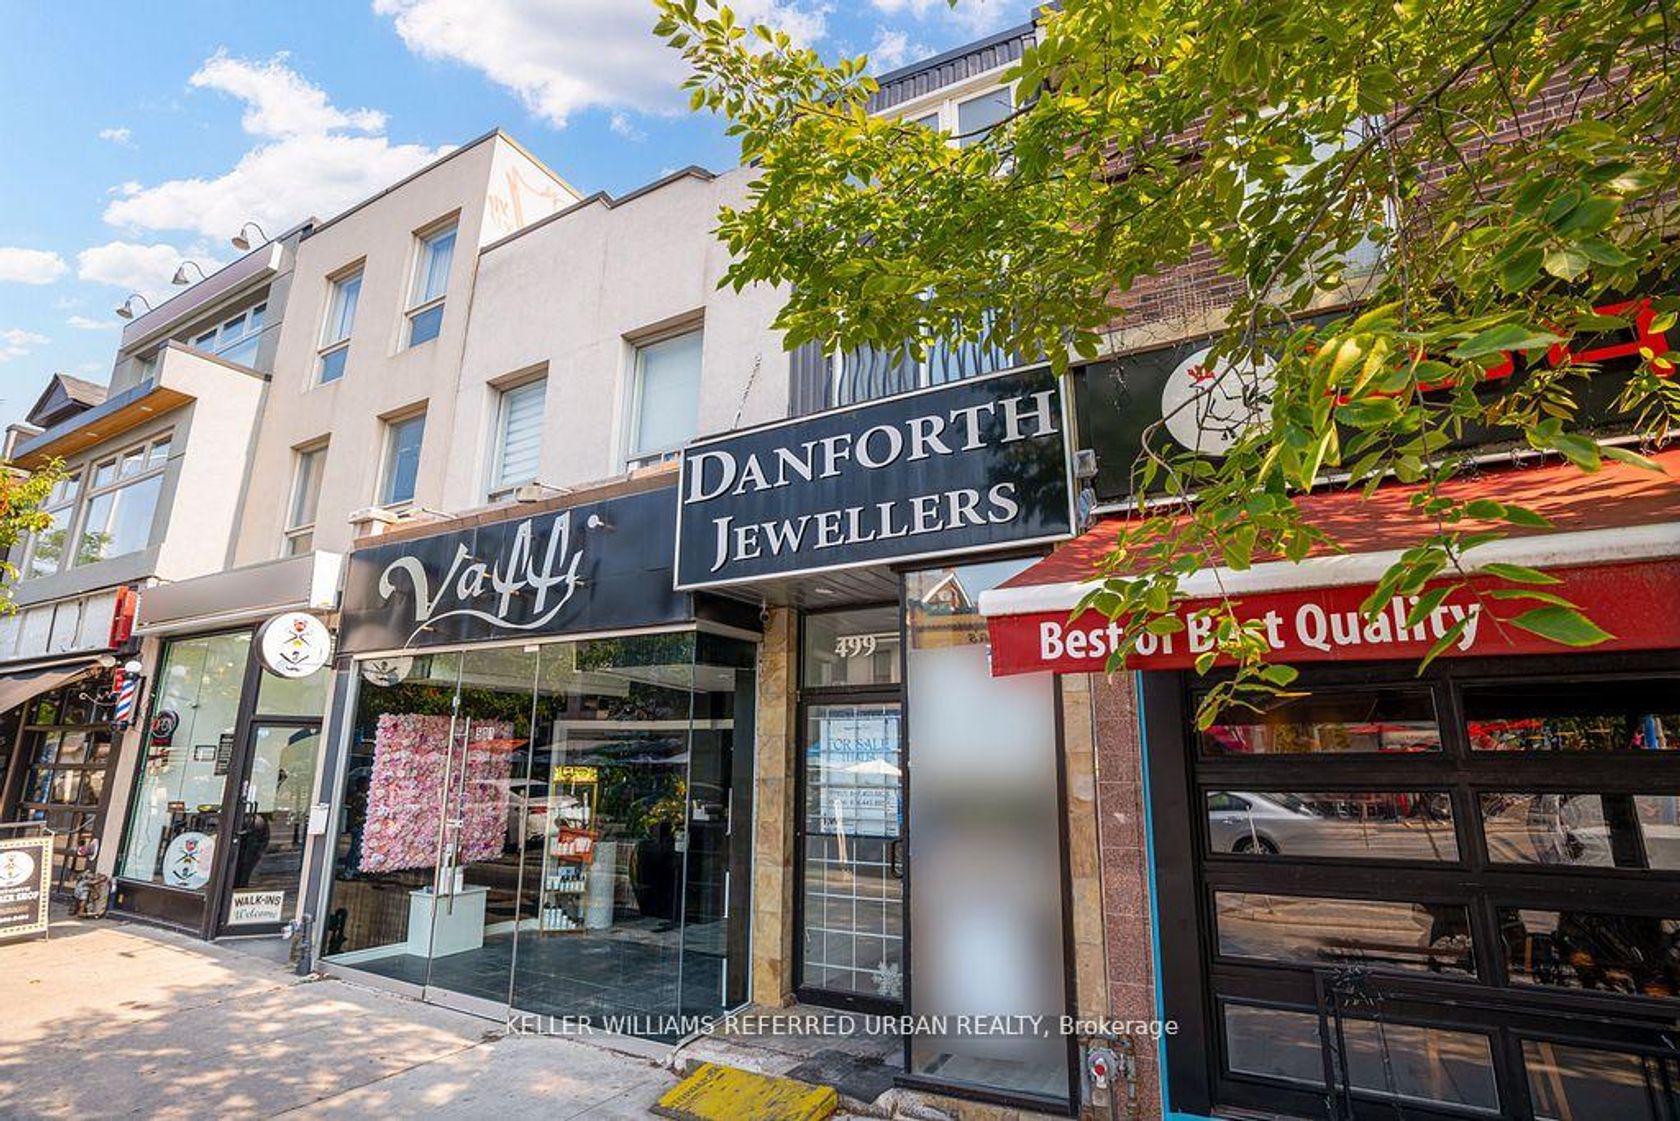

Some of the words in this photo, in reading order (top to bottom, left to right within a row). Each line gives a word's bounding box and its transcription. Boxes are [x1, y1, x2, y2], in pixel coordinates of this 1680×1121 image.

[685, 390, 1059, 504] DANFORTH
[711, 484, 1019, 573] JEWELLERS
[834, 635, 876, 658] 499
[1040, 621, 1124, 660] Best
[1187, 609, 1285, 653] Bt
[1295, 595, 1481, 651] Quality
[234, 895, 282, 907] WALK-INS
